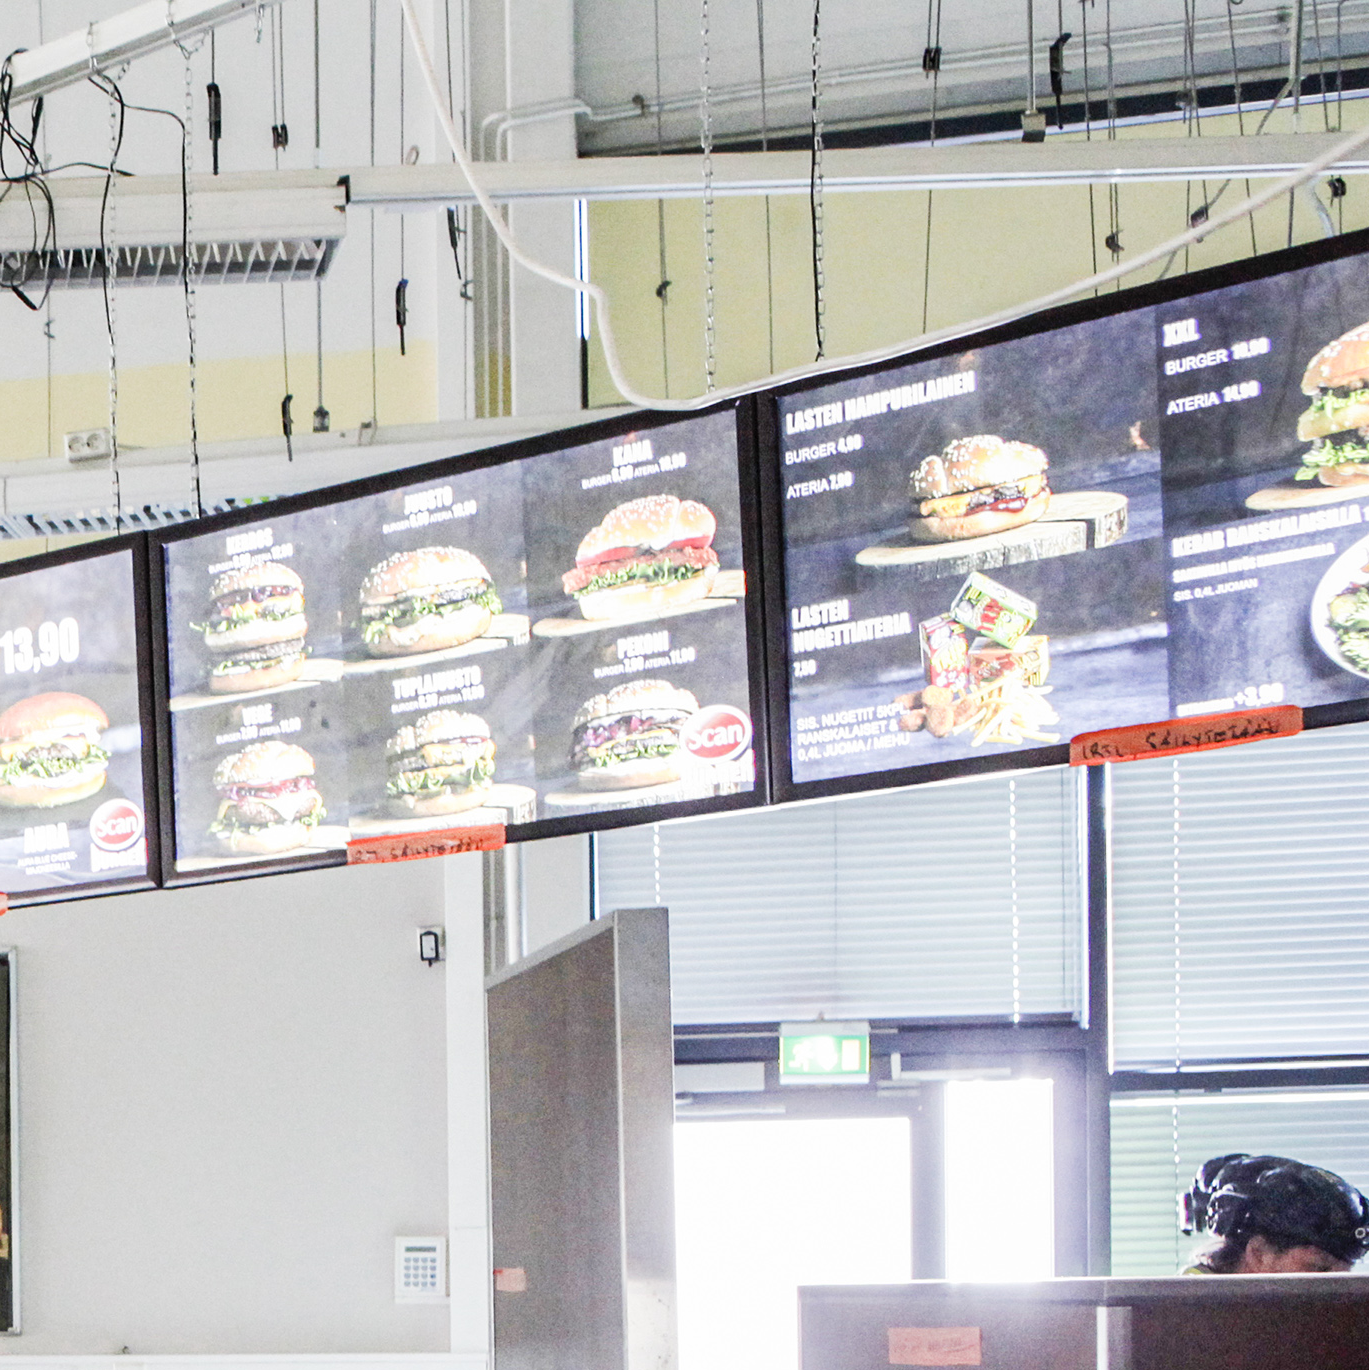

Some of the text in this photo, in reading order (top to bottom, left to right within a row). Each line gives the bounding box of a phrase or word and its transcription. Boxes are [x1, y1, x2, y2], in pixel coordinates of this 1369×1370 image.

[1163, 318, 1200, 347] XXL
[1165, 348, 1229, 375] BURGER
[786, 370, 976, 435] LASTEN HAMPURILAINEN
[1167, 391, 1220, 415] ATERIA
[785, 441, 837, 465] BURGER
[582, 474, 611, 489] BURGER
[634, 463, 660, 478] ATERIA
[787, 479, 829, 499] ATERIA
[430, 510, 453, 523] ATERIA
[1172, 530, 1225, 557] KEBAB
[1215, 577, 1258, 594] JUOMAN
[792, 599, 849, 629] LASTEN
[0, 617, 80, 675] 13,90
[617, 630, 669, 659] PEKONI
[793, 612, 912, 654] NUGETTIATERIA
[594, 664, 624, 678] BURGER
[645, 657, 670, 669] ATERIA
[439, 693, 462, 705] ATERIA
[259, 725, 280, 736] ATERIA
[796, 716, 819, 731] SIS.
[821, 707, 874, 726] NUGETIT
[688, 723, 743, 751] Scan
[797, 720, 887, 746] RANSKALAISET
[798, 747, 822, 762] 0,4L
[823, 739, 866, 757] JUOMA
[873, 732, 910, 749] MEHU
[96, 815, 137, 840] Scan
